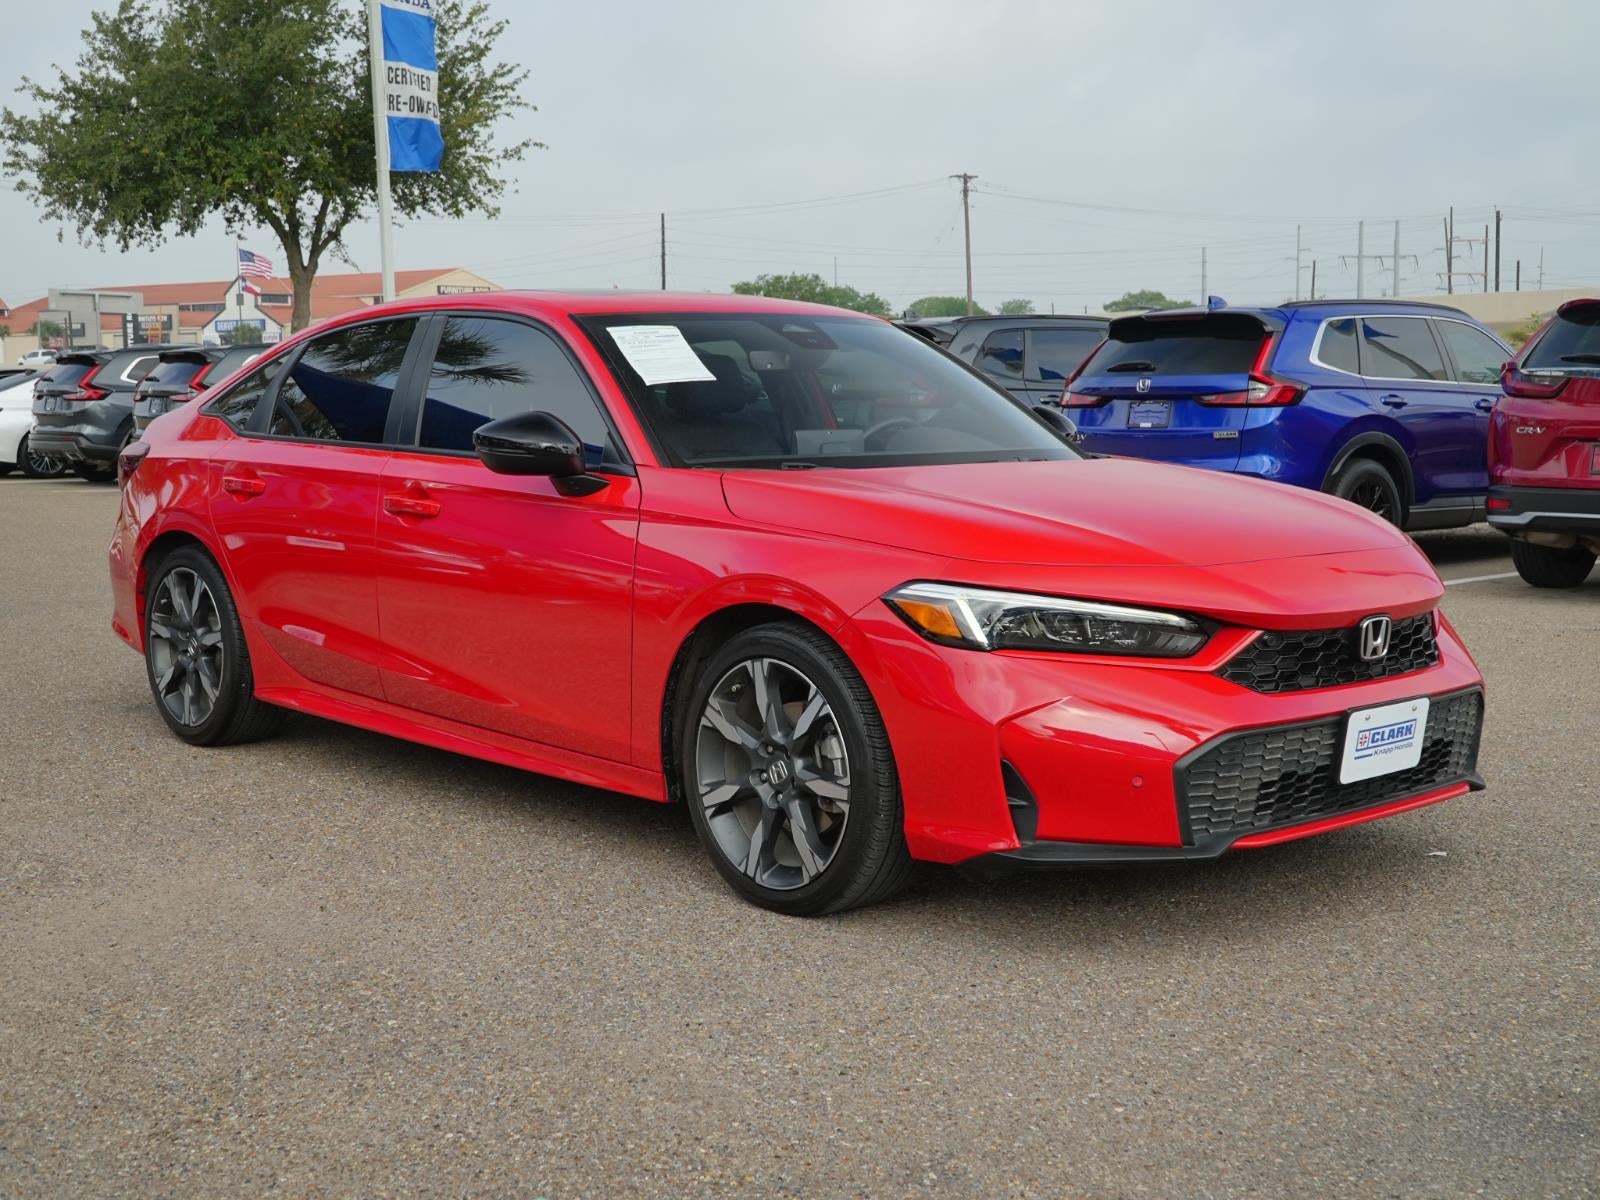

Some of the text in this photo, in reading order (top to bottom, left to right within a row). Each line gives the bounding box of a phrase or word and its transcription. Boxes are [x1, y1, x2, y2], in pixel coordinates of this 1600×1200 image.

[1515, 426, 1546, 434] CR-V
[1370, 723, 1414, 745] CLARK
[1373, 741, 1414, 757] Knapp Honda
